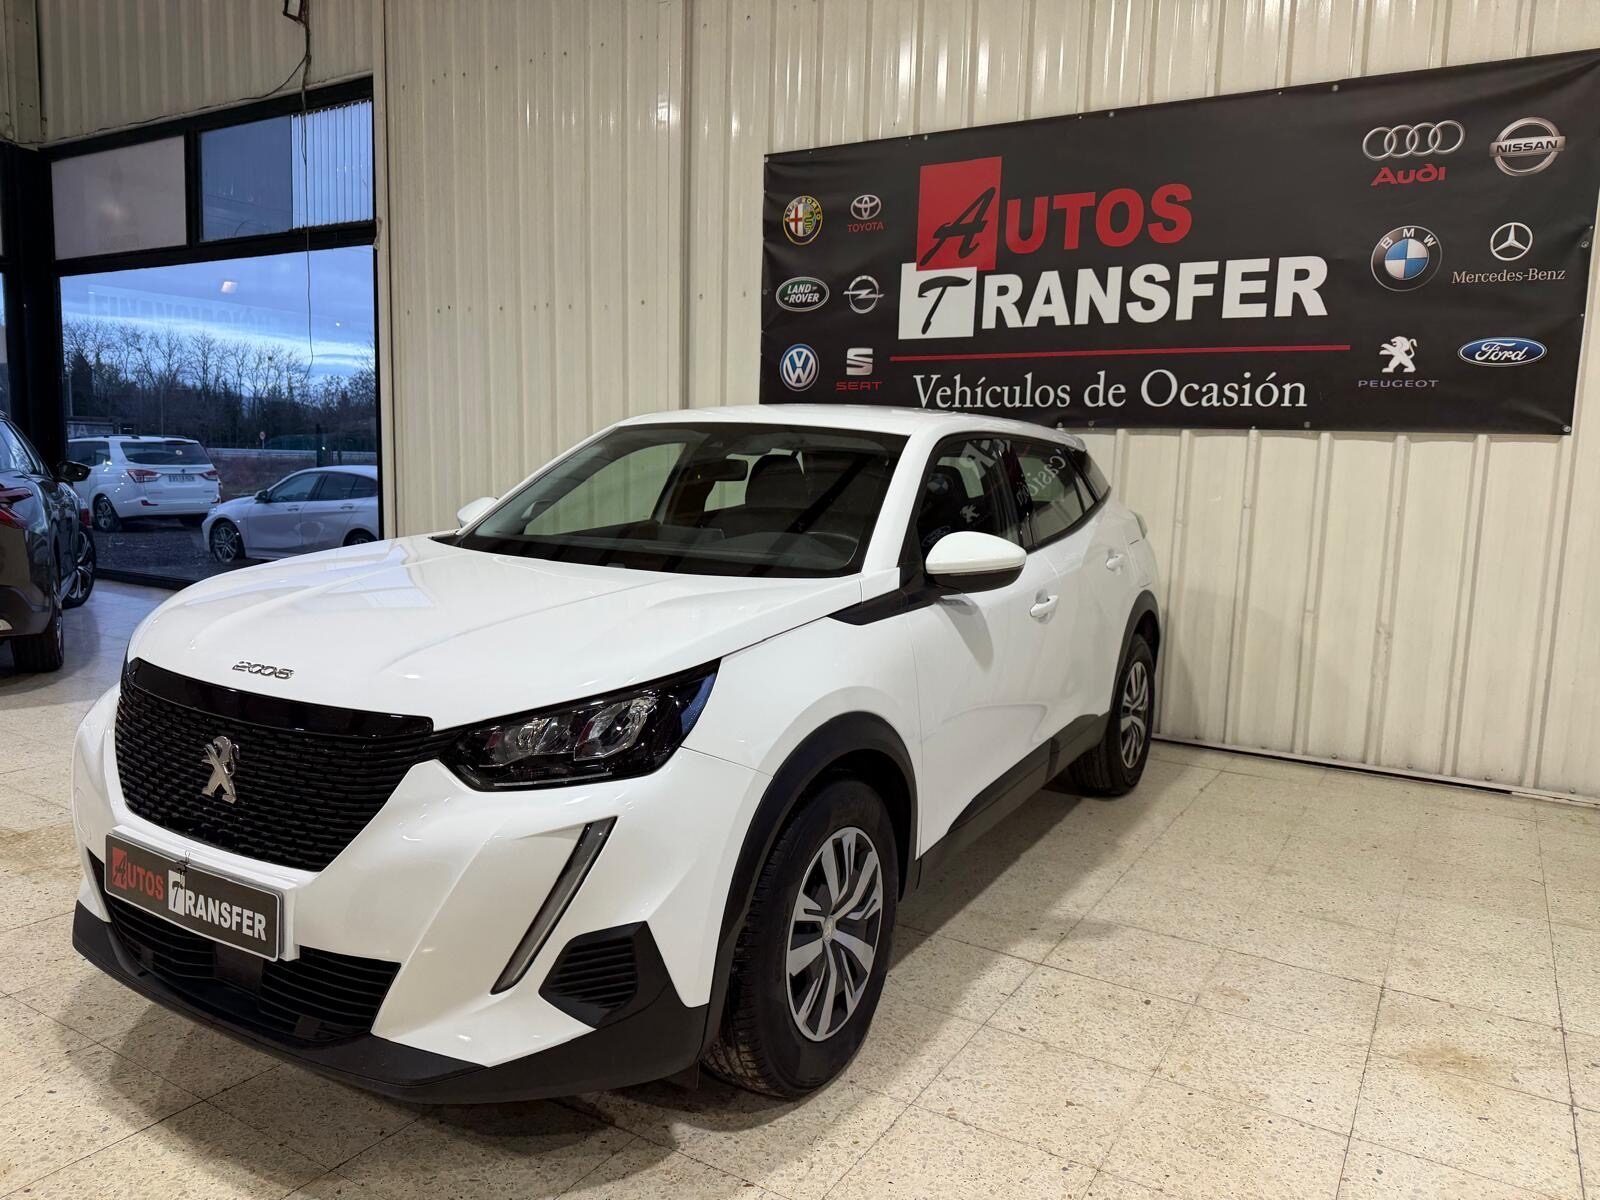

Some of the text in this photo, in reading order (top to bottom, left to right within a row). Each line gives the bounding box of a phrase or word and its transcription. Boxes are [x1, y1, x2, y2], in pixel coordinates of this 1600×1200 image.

[1495, 139, 1558, 153] NISSAN
[1370, 163, 1447, 186] Audi
[847, 222, 884, 233] TOYOTA
[919, 184, 1193, 266] AUTOS
[1381, 227, 1437, 251] BMW
[1451, 268, 1566, 284] Mercedes-Benz
[787, 284, 812, 294] LAND
[788, 293, 820, 304] ROVER
[917, 256, 1329, 335] TRANSFER
[1475, 341, 1528, 362] Ford
[835, 381, 883, 391] SEAT
[912, 369, 1308, 409] Vehículos de Ocasión
[1357, 379, 1441, 389] PEUGEOT
[231, 660, 295, 680] 2008
[111, 853, 267, 942] AUTOS TRANSFER
